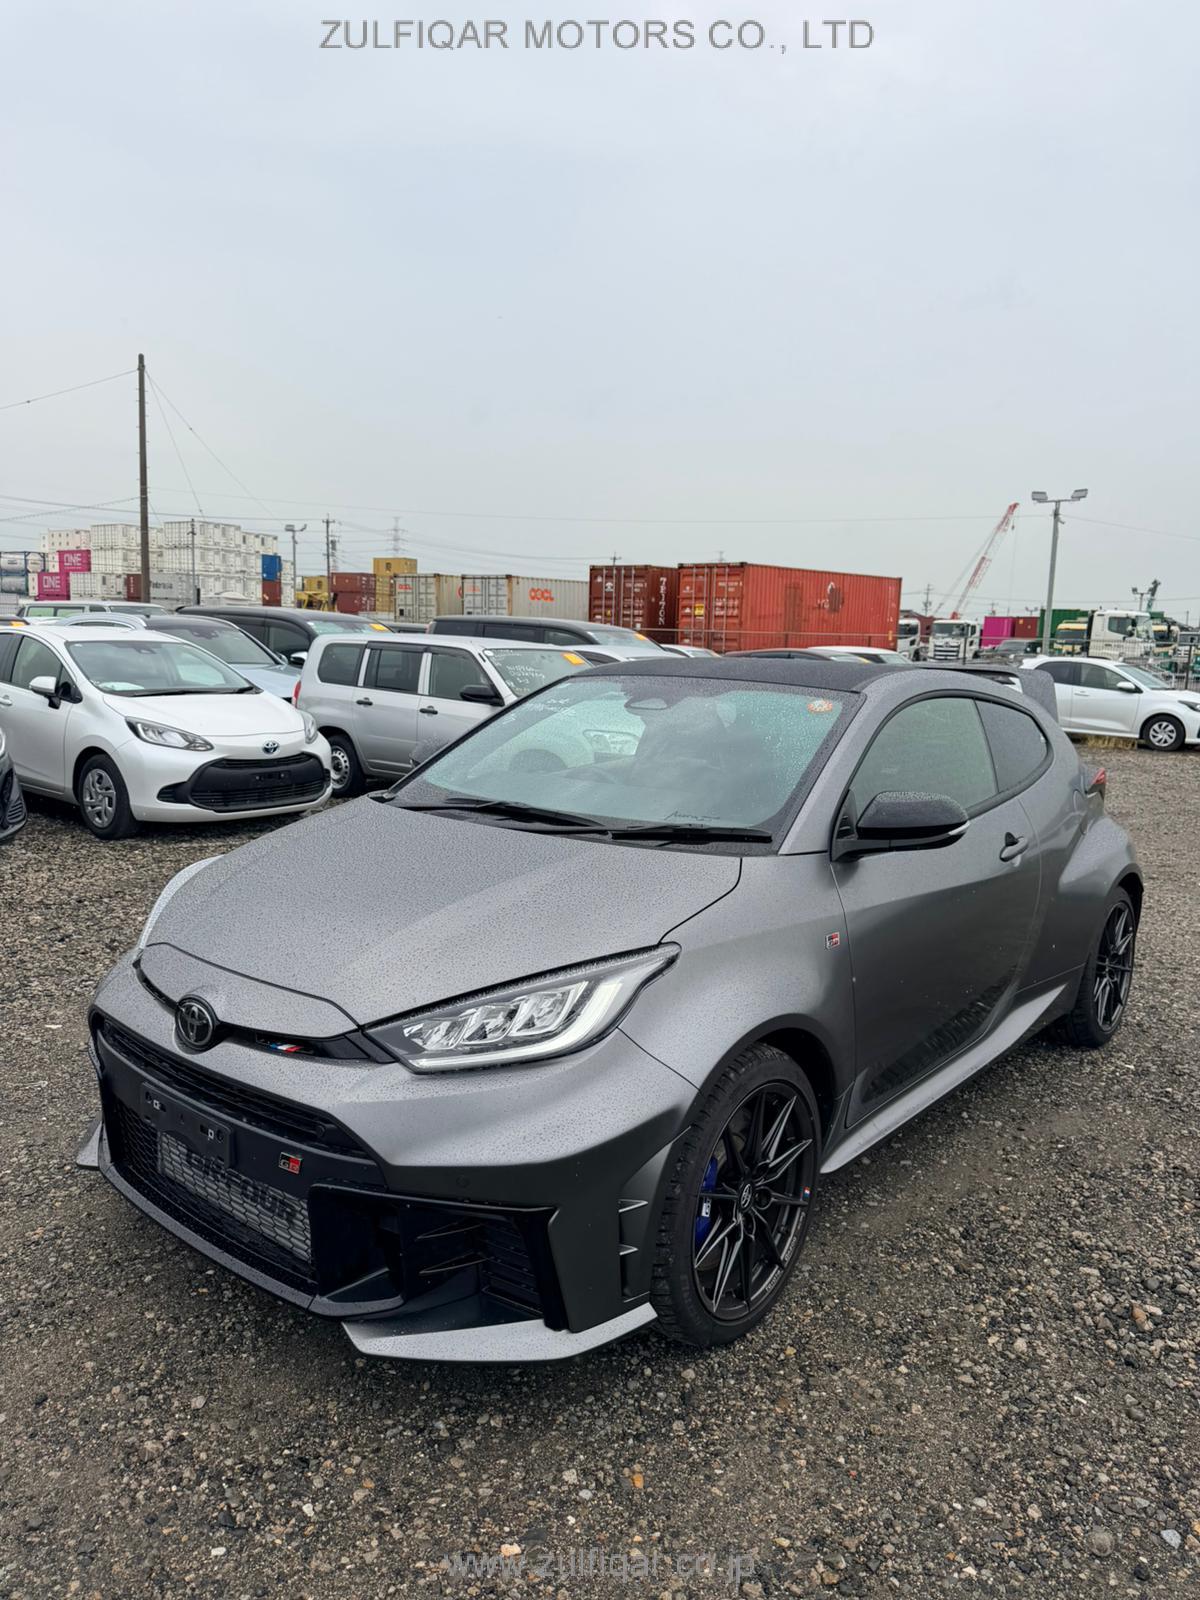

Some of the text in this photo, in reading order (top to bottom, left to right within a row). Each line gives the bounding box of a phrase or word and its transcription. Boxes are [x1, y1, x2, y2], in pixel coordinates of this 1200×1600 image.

[64, 553, 82, 566] ONE
[43, 575, 61, 588] ONE
[529, 588, 555, 602] OOCL
[279, 1157, 300, 1174] GR
